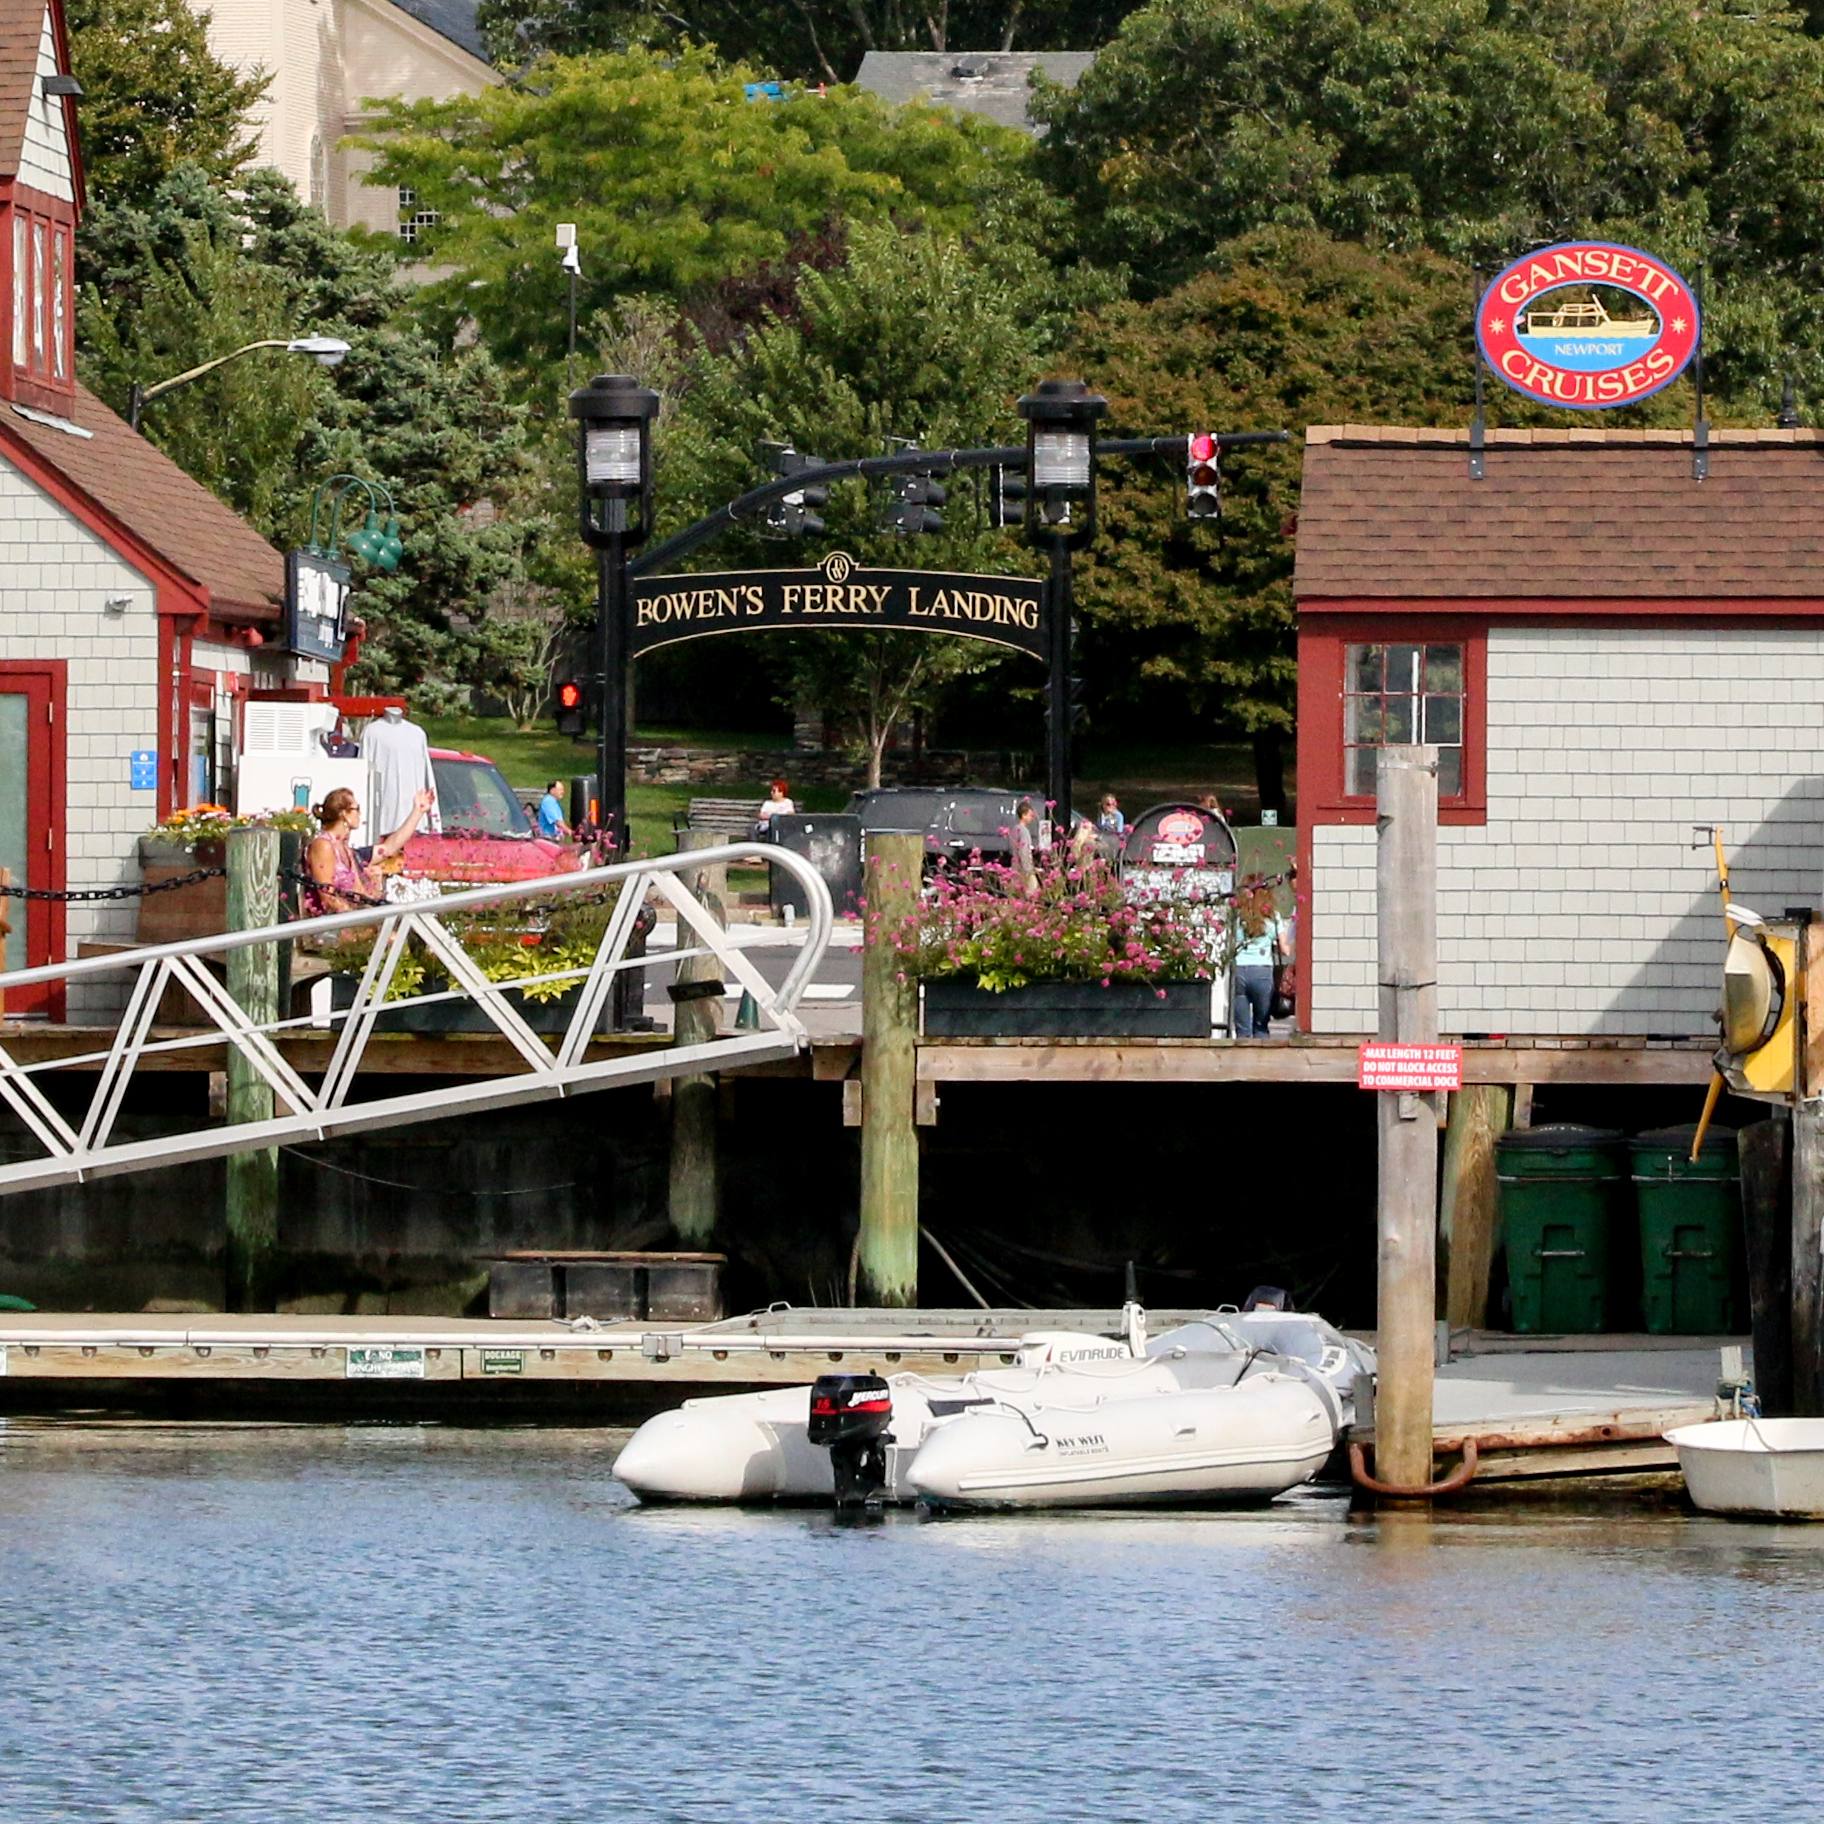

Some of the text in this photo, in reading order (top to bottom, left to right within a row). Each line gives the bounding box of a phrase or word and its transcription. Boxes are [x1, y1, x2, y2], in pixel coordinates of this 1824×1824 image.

[1500, 250, 1679, 304] GANSETT
[1555, 343, 1624, 356] NEWPORT
[1501, 348, 1675, 401] CRUISES
[636, 584, 1039, 629] BOWEN'S FERRY LANDING
[1387, 1048, 1422, 1060] LENGTH
[1423, 1049, 1434, 1060] 12
[1363, 1061, 1458, 1074] DO NOT BLOCK ACCESS
[1362, 1075, 1459, 1087] TO COMMERCIAL DOCK
[378, 1351, 393, 1360] NO
[484, 1350, 522, 1360] DOCKAGE
[1059, 1346, 1125, 1363] EVINRUDE
[1054, 1434, 1106, 1448] KEY WEST
